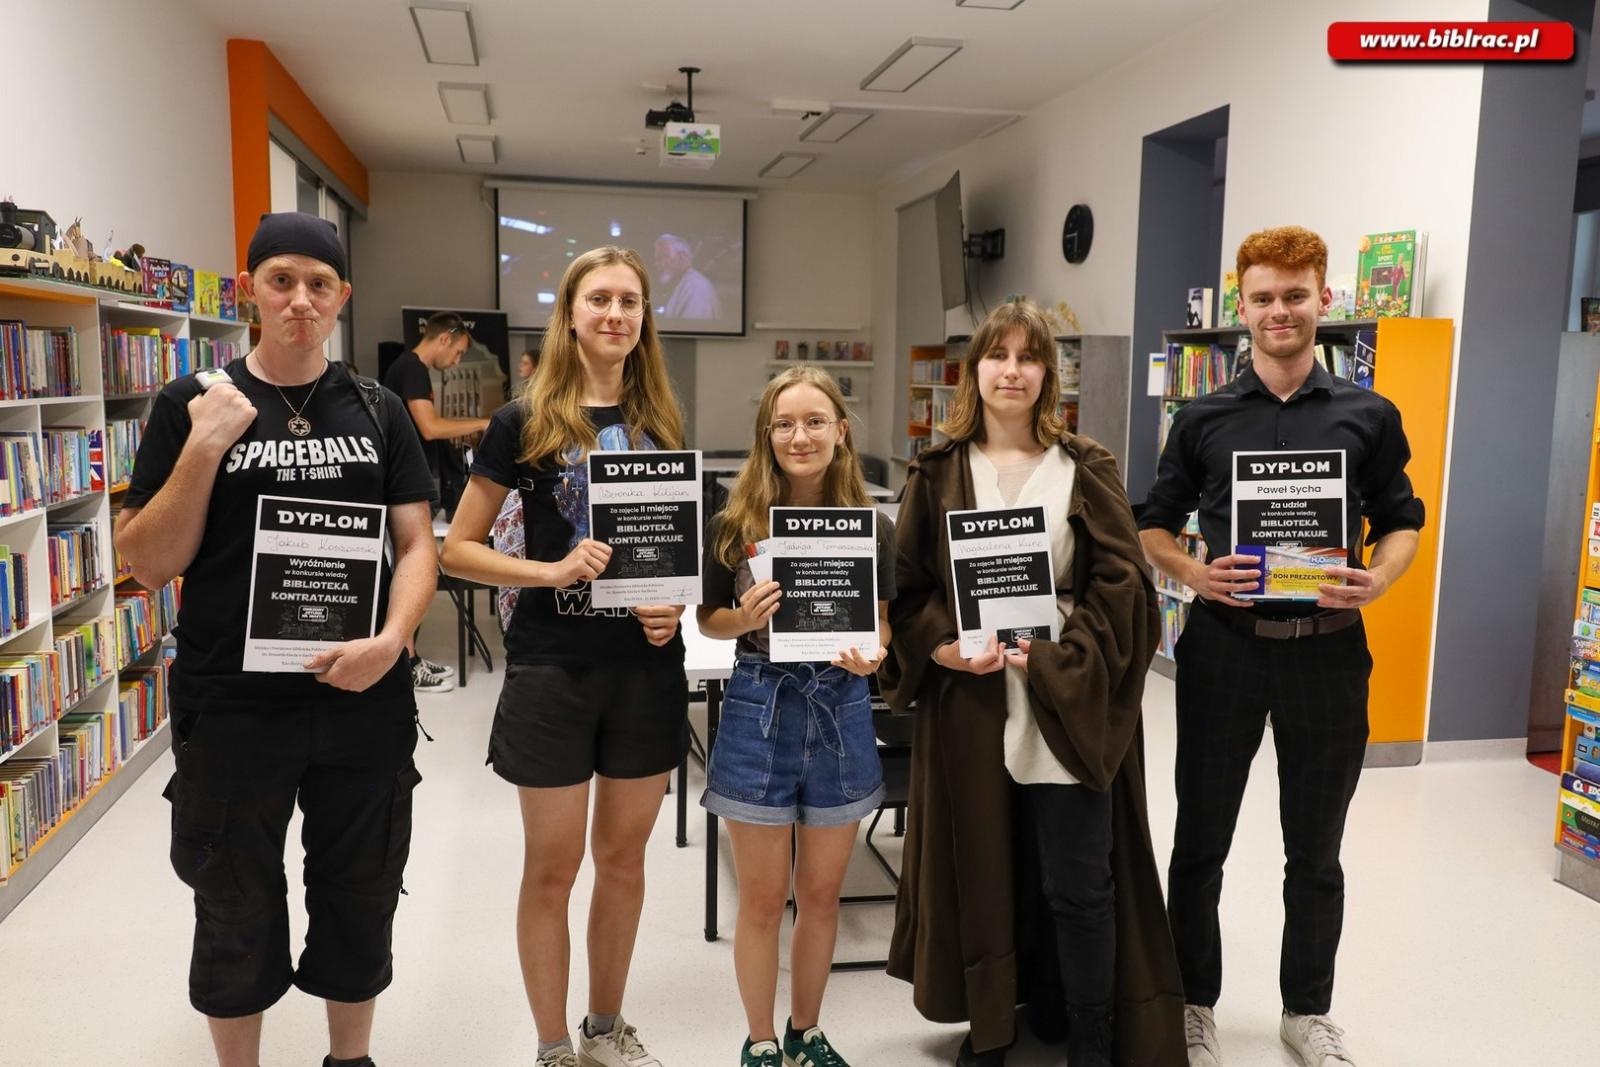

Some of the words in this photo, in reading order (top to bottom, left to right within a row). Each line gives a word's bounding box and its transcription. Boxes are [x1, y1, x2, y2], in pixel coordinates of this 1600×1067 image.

[225, 436, 379, 473] SPACEBALLS
[276, 468, 296, 481] THE
[300, 465, 343, 481] T-SHIRT
[604, 462, 685, 476] DYPLOM
[1250, 461, 1330, 475] DYPLOM
[1257, 485, 1288, 494] Paweł
[1289, 484, 1322, 495] Sycha
[646, 504, 679, 514] miejsca
[1270, 501, 1281, 509] Za
[277, 510, 369, 530] DYPLOM
[652, 514, 673, 522] wiedzy
[1260, 519, 1319, 527] BIBLIOTEKA
[616, 524, 675, 533] BIBLIOTEKA
[785, 518, 862, 531] DYPLOM
[962, 516, 1034, 533] DYPLOM
[608, 534, 684, 545] KONTRATAKUJE
[1251, 530, 1328, 538] KONTRATAKUJE
[266, 534, 310, 552] Jakub
[289, 558, 346, 569] Wyróżnienie
[823, 560, 855, 569] miejsca
[1003, 556, 1033, 565] miejsca
[291, 569, 325, 577] konkursie
[325, 571, 349, 579] wiedzy
[977, 573, 1029, 585] BIBLIOTEKA
[283, 580, 350, 591] BIBLIOTEKA
[970, 584, 1039, 597] KONTRATAKUJE
[271, 591, 358, 604] KONTRATAKUJE
[786, 590, 860, 598] KONTRATAKUJE
